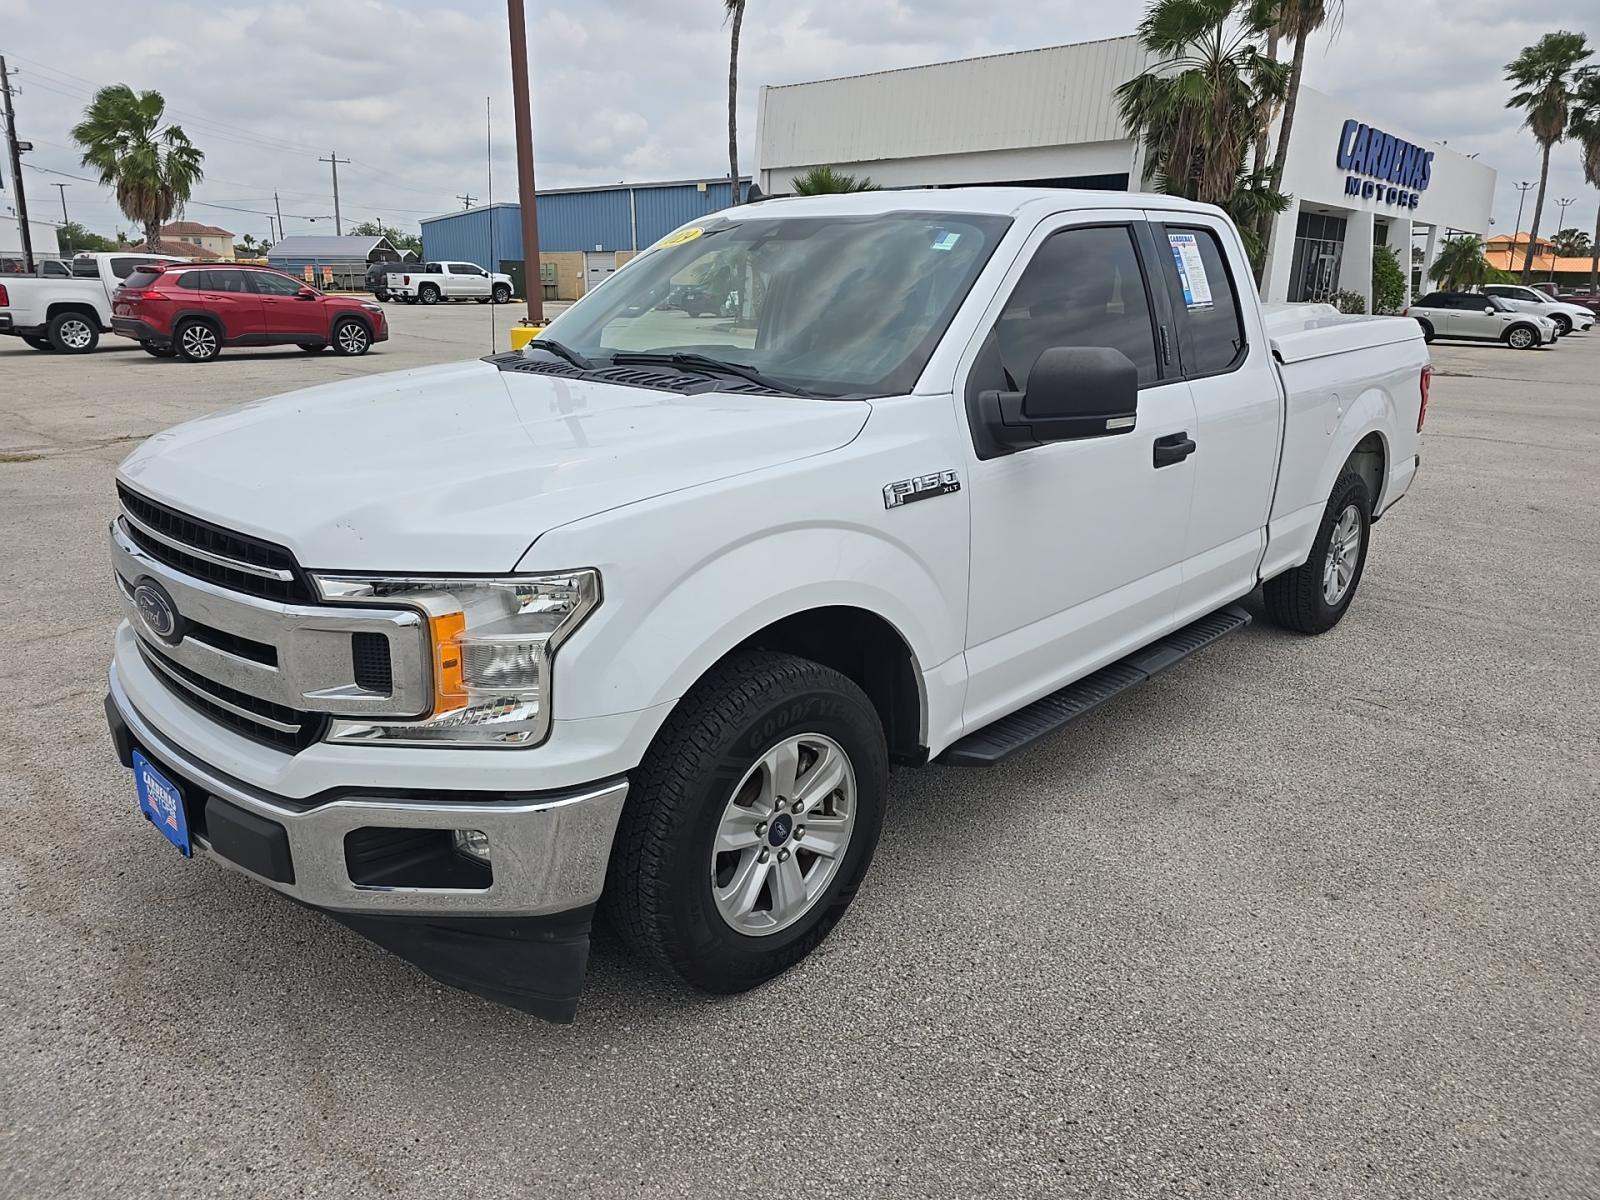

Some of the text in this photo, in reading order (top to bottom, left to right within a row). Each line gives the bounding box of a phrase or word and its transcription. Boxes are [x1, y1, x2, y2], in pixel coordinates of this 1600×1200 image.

[1337, 119, 1435, 191] CARDENAS
[1345, 176, 1419, 210] MOTORS
[943, 484, 959, 493] XLT
[140, 595, 162, 627] Ford
